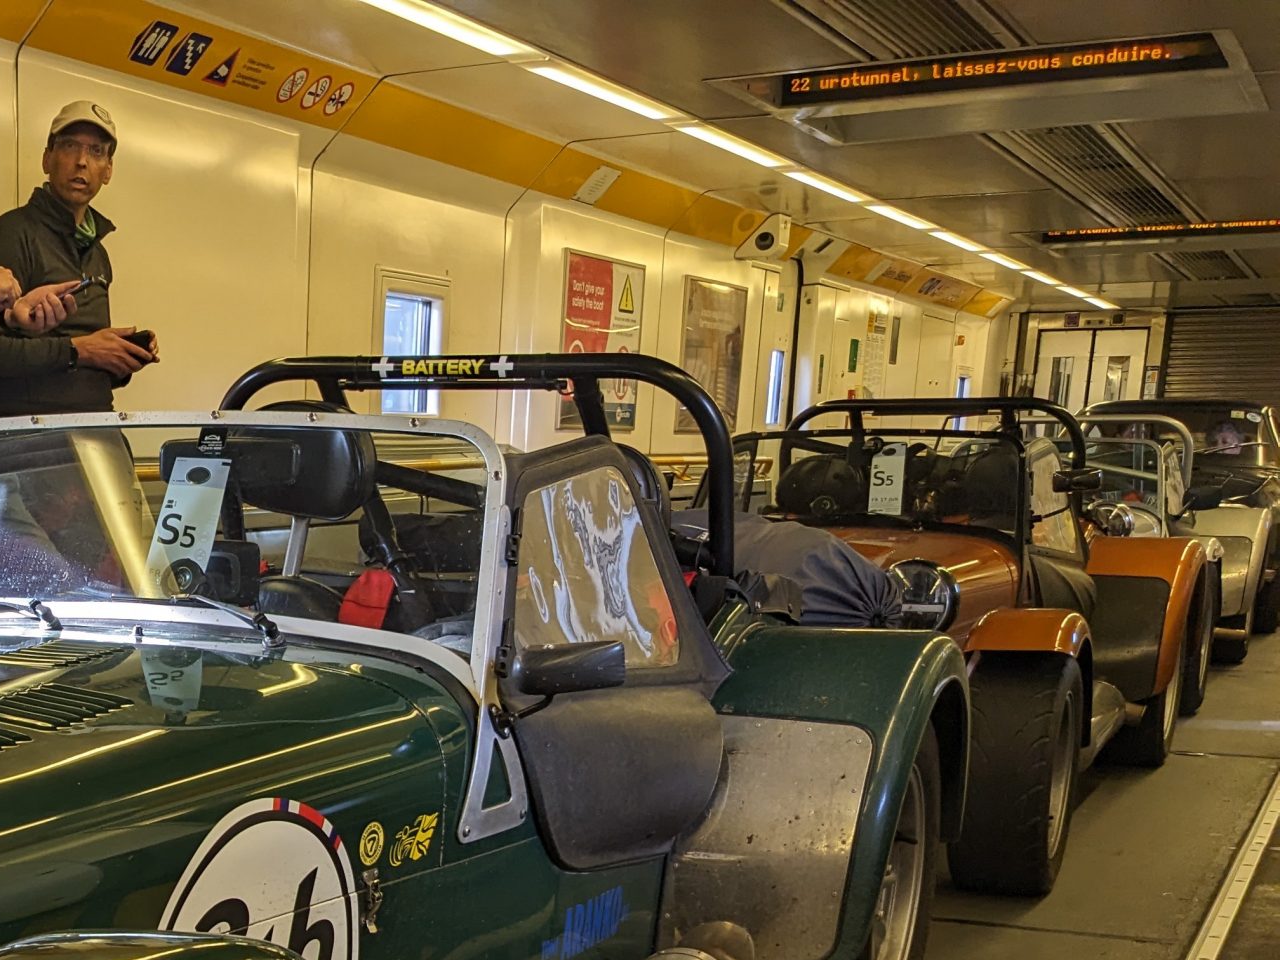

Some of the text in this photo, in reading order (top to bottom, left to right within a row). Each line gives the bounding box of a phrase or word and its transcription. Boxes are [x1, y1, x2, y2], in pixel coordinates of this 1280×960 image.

[790, 46, 1172, 92] 22 urotunnel, laissez-vous conduire.
[401, 359, 486, 375] BATTERY
[872, 470, 894, 487] S5
[157, 513, 197, 548] S5
